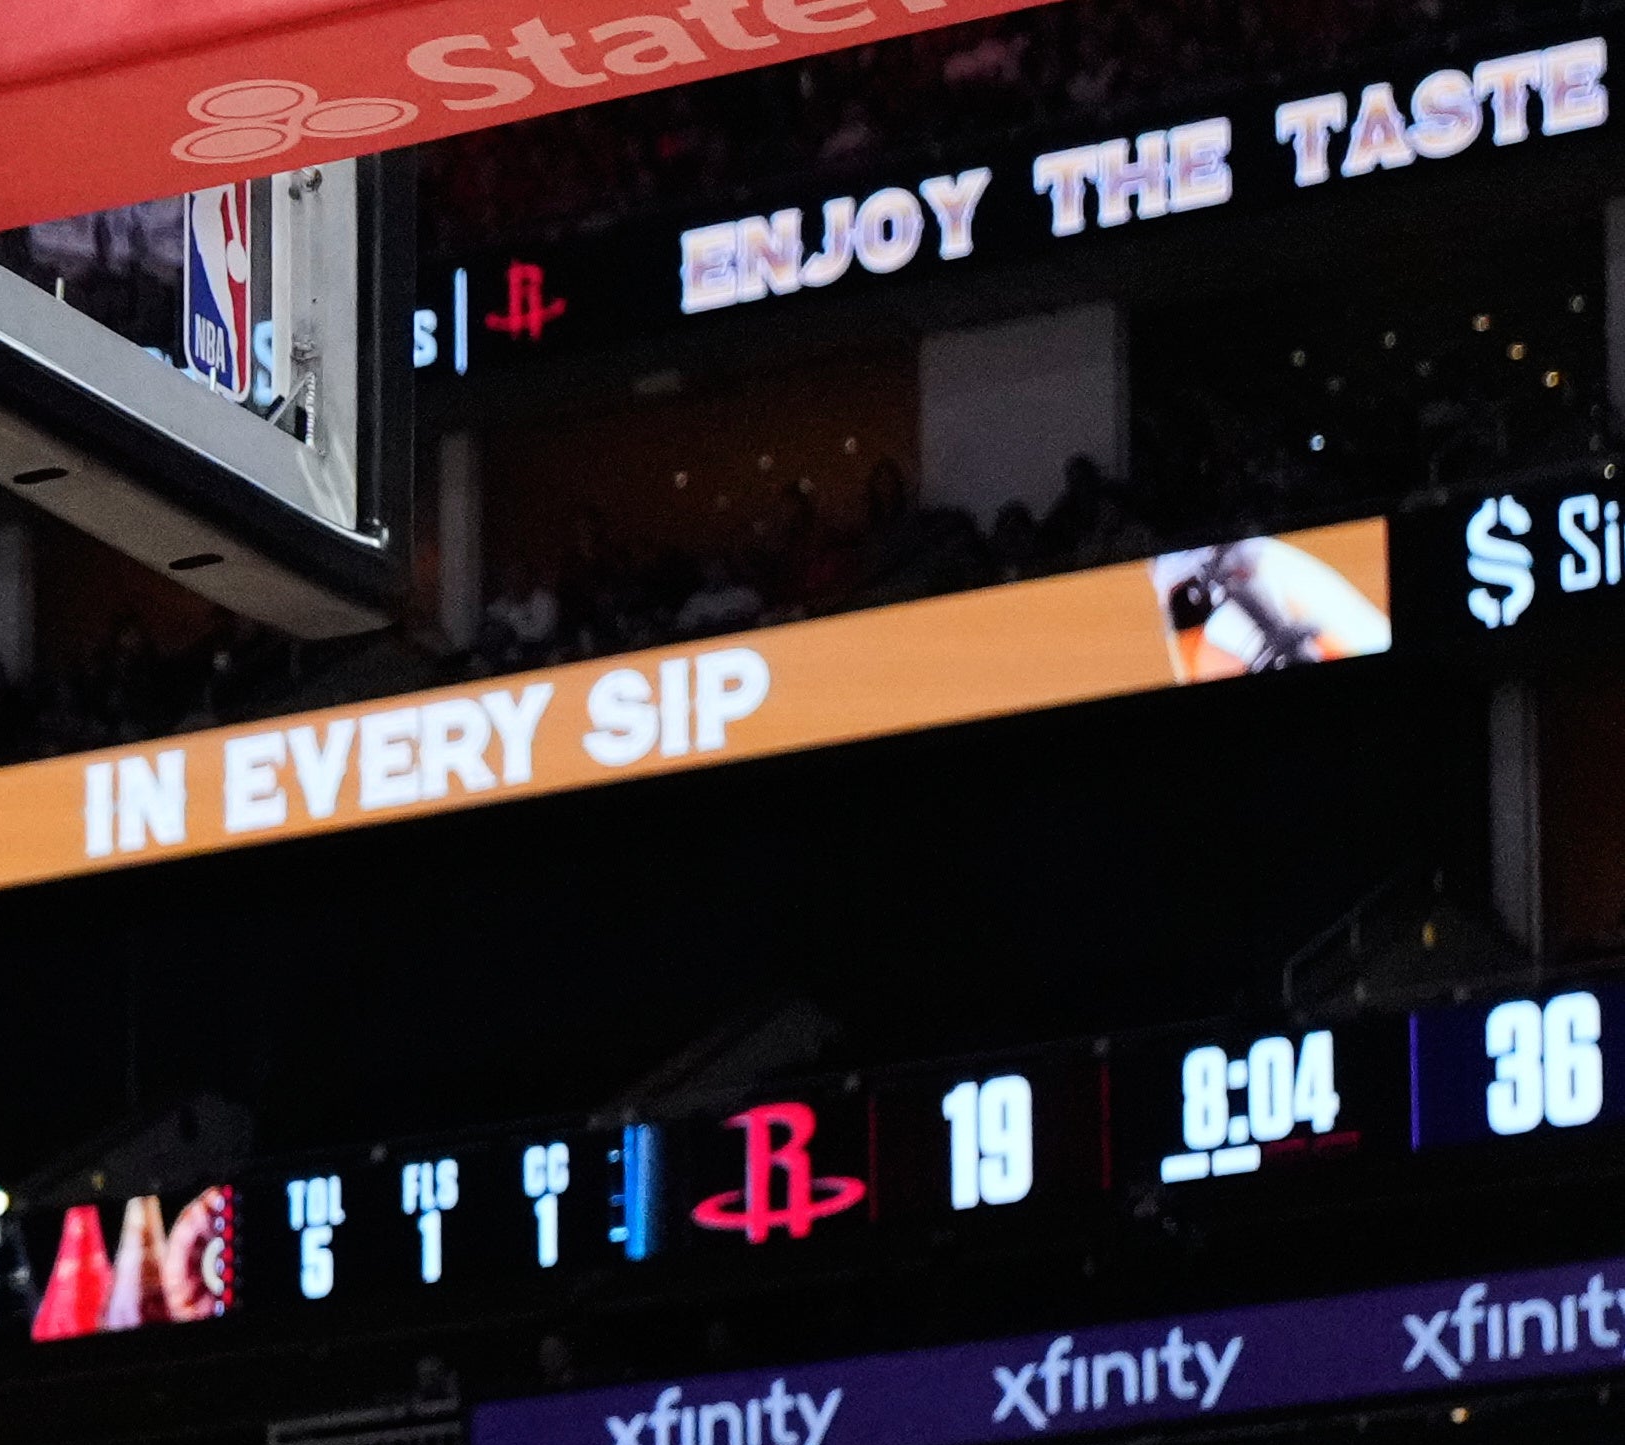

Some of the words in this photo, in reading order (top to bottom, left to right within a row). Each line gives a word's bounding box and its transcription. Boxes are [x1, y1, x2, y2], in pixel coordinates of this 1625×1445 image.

[406, 0, 876, 112] State
[680, 167, 992, 314] ENJOY
[1033, 117, 1232, 237] THE
[1275, 37, 1608, 187] TASTE
[194, 313, 227, 374] NBA
[1558, 494, 1625, 592] Si
[83, 748, 188, 858] IN
[223, 682, 554, 834] EVERY
[582, 647, 771, 767] SIP
[1181, 1030, 1340, 1150] 8:04
[1485, 991, 1603, 1135] 36
[402, 1158, 459, 1214] FLS
[942, 1075, 1033, 1210] 19
[287, 1175, 346, 1231] TOL
[418, 1209, 442, 1283] 1
[534, 1193, 558, 1268] 1
[301, 1225, 334, 1299] 5
[992, 1326, 1243, 1431] xfinity
[1402, 1272, 1625, 1381] xfinit
